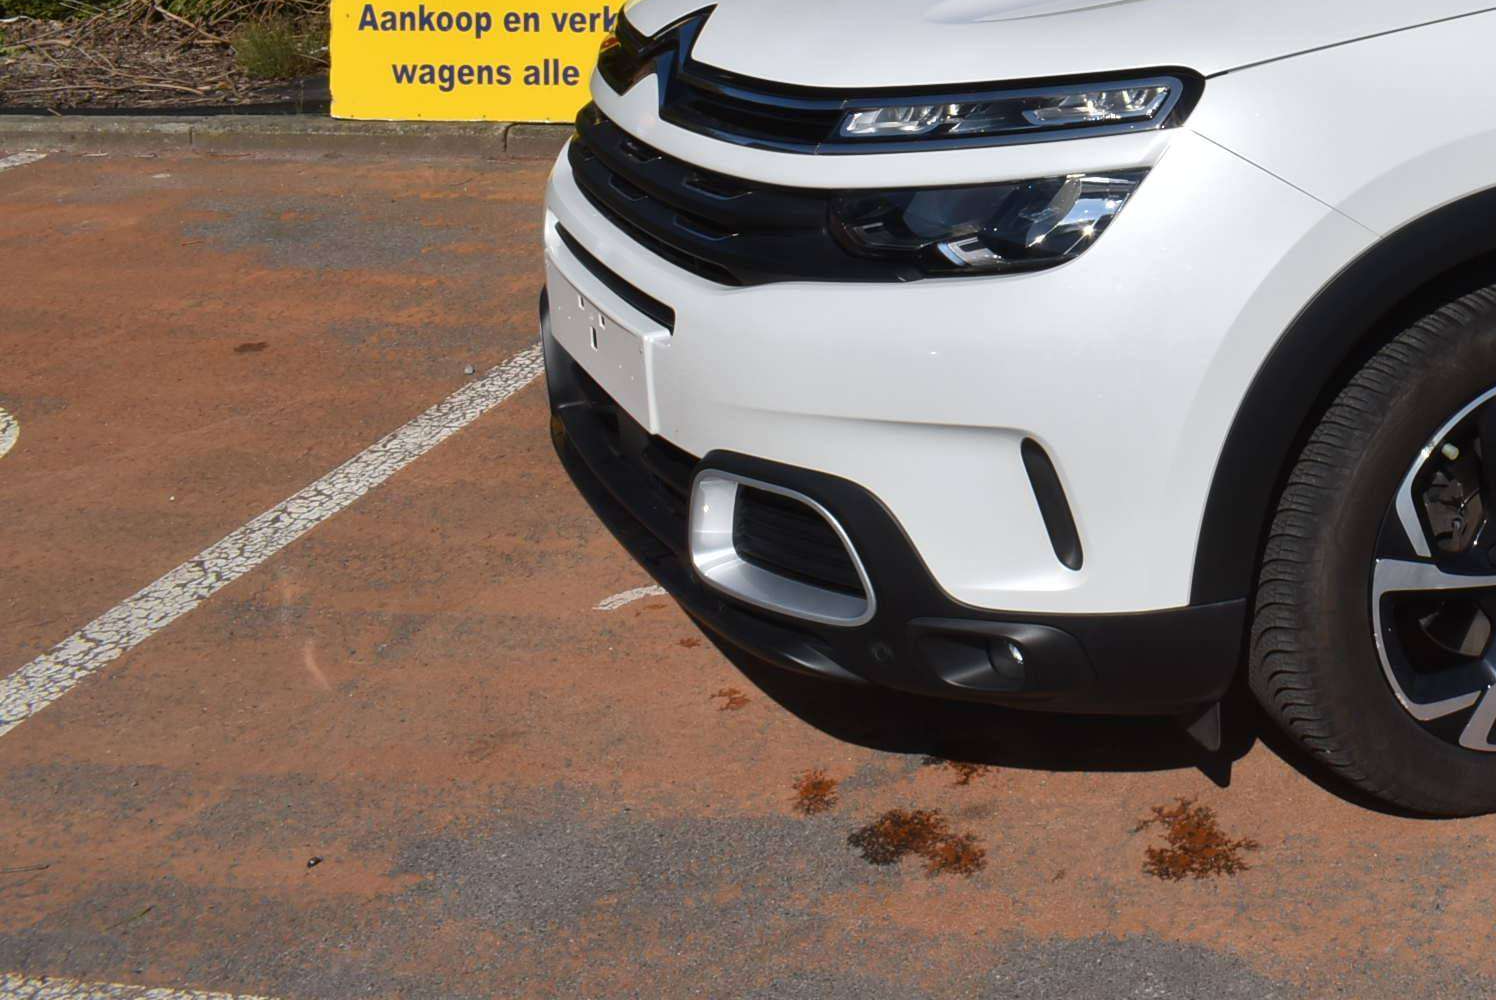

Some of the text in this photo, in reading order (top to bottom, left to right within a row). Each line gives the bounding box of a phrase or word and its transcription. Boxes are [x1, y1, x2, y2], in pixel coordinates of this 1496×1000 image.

[358, 3, 492, 40] Aankoop
[503, 11, 540, 33] en
[391, 58, 580, 93] wagens alle
